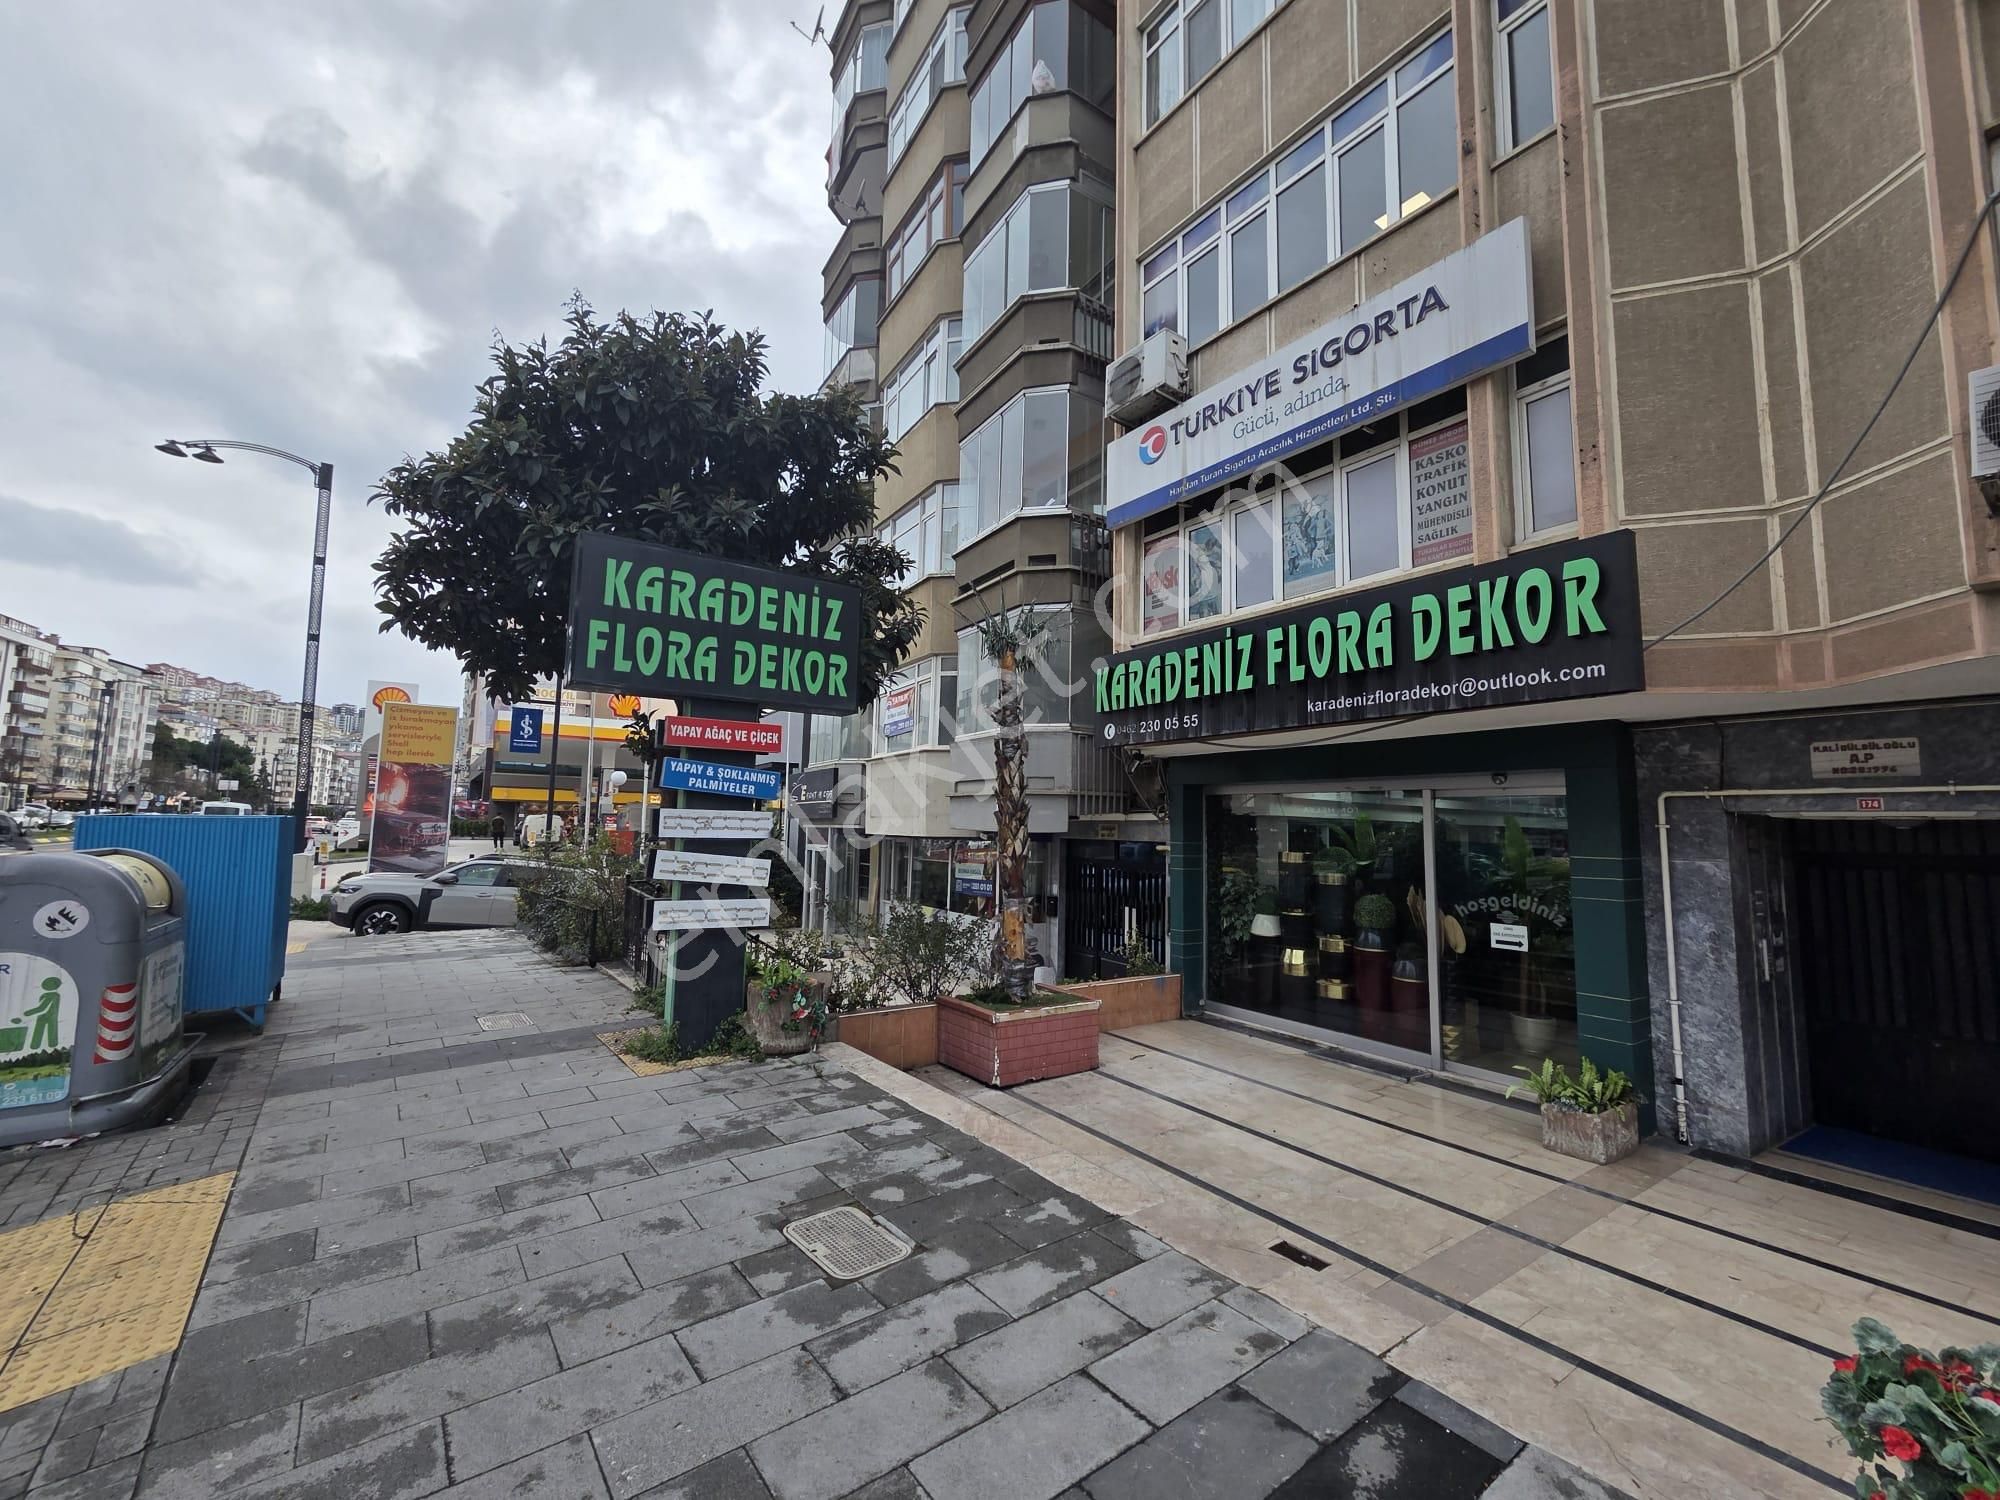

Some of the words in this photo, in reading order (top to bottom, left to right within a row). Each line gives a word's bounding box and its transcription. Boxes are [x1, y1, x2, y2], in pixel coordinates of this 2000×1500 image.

[1170, 368, 1281, 445] TÜRKİYE
[1292, 285, 1450, 384] SİGORTA
[1233, 406, 1279, 439] Gücü,
[1200, 469, 1223, 483] Turan
[1258, 437, 1294, 459] Aracılık
[1351, 405, 1374, 418] Ltd.
[1415, 444, 1467, 472] KASKO
[1415, 459, 1468, 484] TRAFİK
[1416, 473, 1468, 501] KONUT
[1416, 490, 1469, 515] YANGIN
[1417, 505, 1473, 531] MÜHENDİSLİ
[1417, 524, 1459, 544] SAĞLIK
[604, 558, 844, 642] KARADENİZ
[1096, 626, 1254, 713] KARADENİZ
[1267, 602, 1393, 685] FLORA
[1411, 556, 1608, 663] DEKOR
[586, 618, 719, 682] FLORA
[732, 640, 849, 697] DEKOR
[1306, 663, 1606, 713] karadenizfloradekor@outlook.com
[670, 724, 703, 739] YAPAY
[704, 726, 732, 743] AĞAÇ
[735, 730, 748, 742] VE
[750, 729, 779, 746] ÇİÇEK
[1139, 719, 1161, 733] 230
[1164, 717, 1180, 730] 05
[1183, 713, 1199, 728] 55
[386, 739, 409, 747] Shell
[670, 761, 703, 775] YAPAY
[706, 766, 714, 777] &
[717, 767, 776, 787] ŞOKLANMIŞ
[688, 777, 755, 795] PALMİYELER
[1861, 800, 1879, 808] 174
[1454, 893, 1568, 928] hoşgeldiniz
